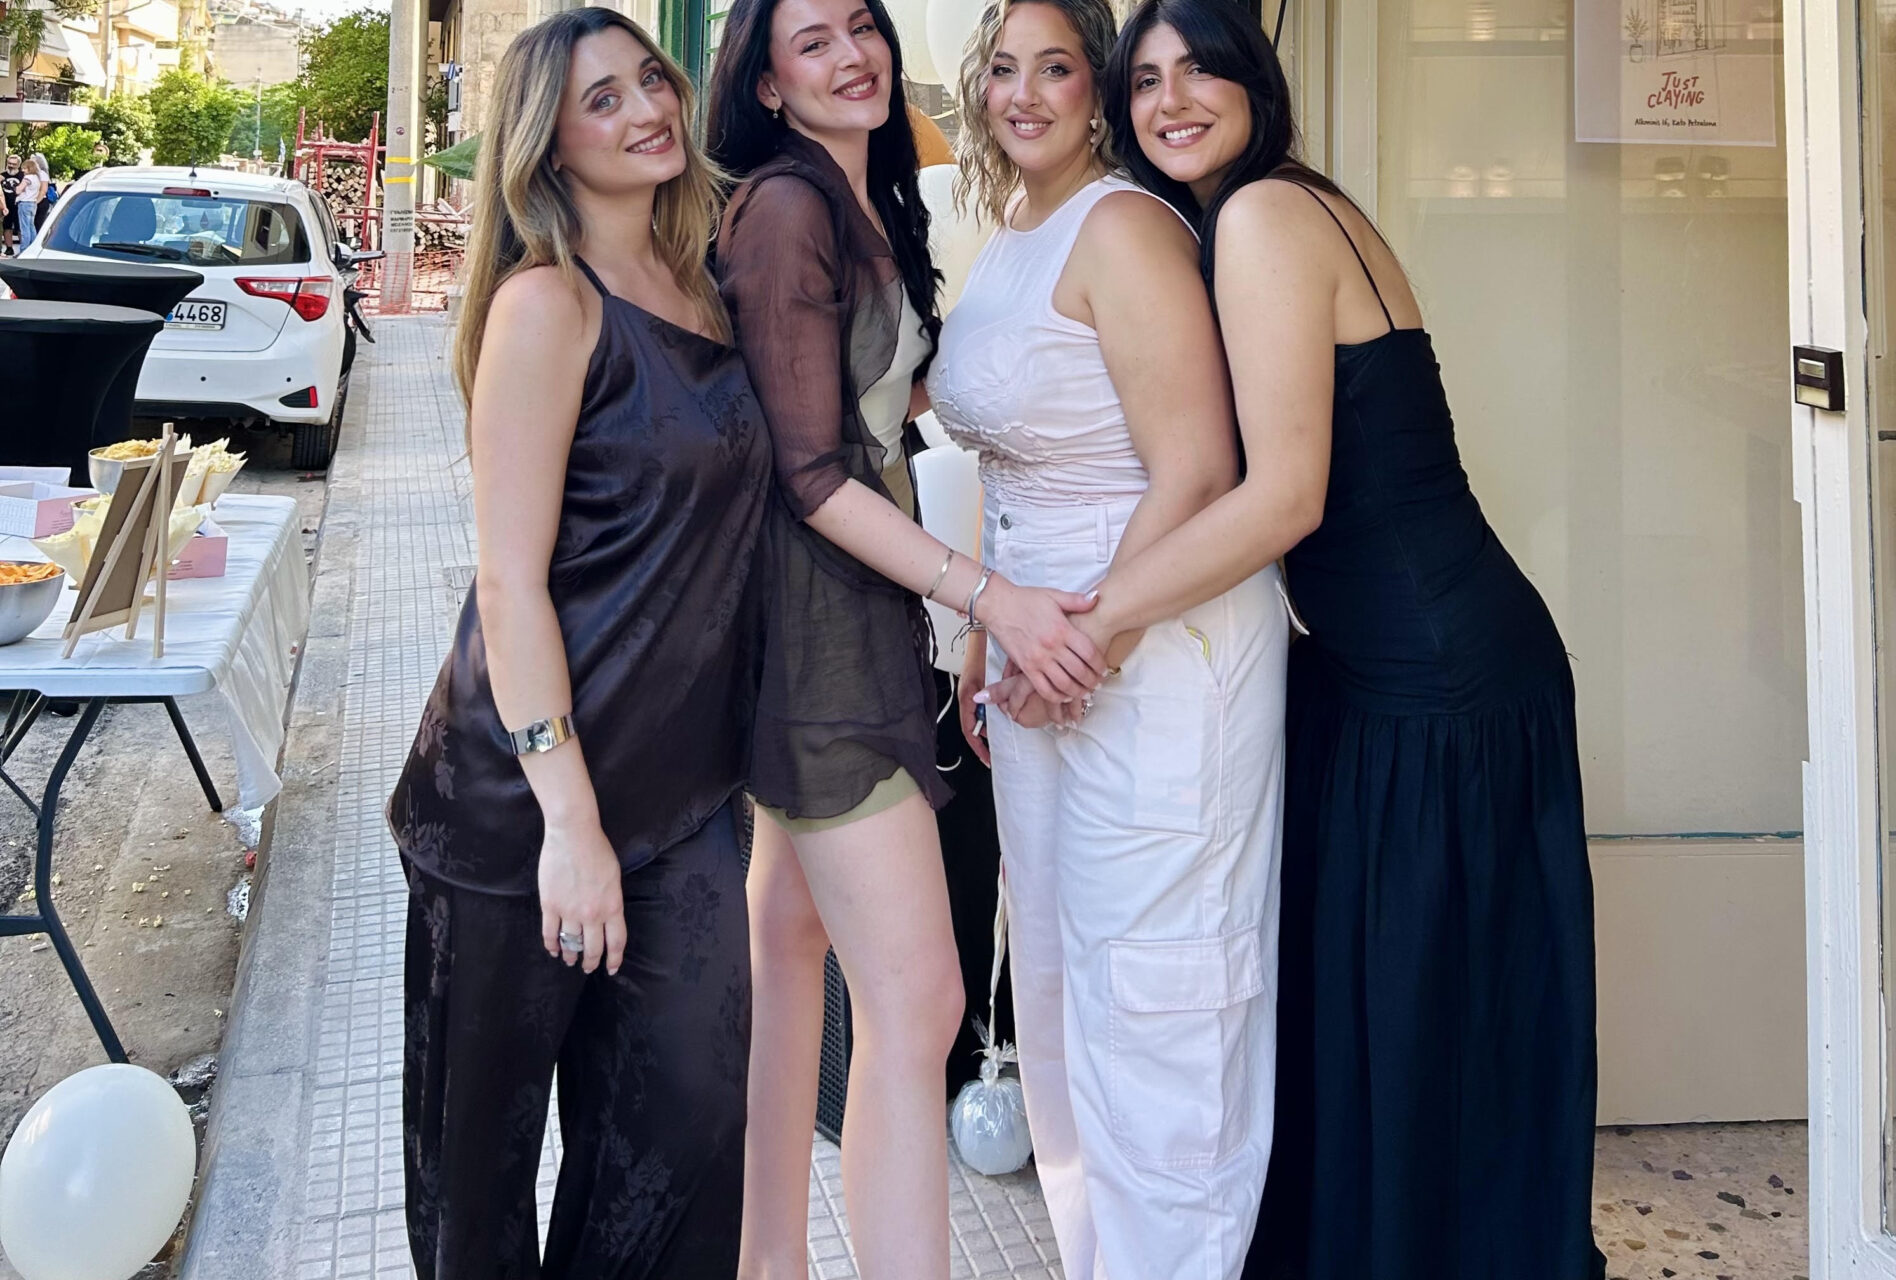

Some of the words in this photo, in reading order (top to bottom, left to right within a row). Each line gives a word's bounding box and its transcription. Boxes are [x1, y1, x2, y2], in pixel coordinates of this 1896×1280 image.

[1661, 71, 1699, 92] JUST
[1647, 88, 1705, 110] CLAYING
[1672, 118, 1686, 126] Kato
[174, 304, 222, 322] 4468
